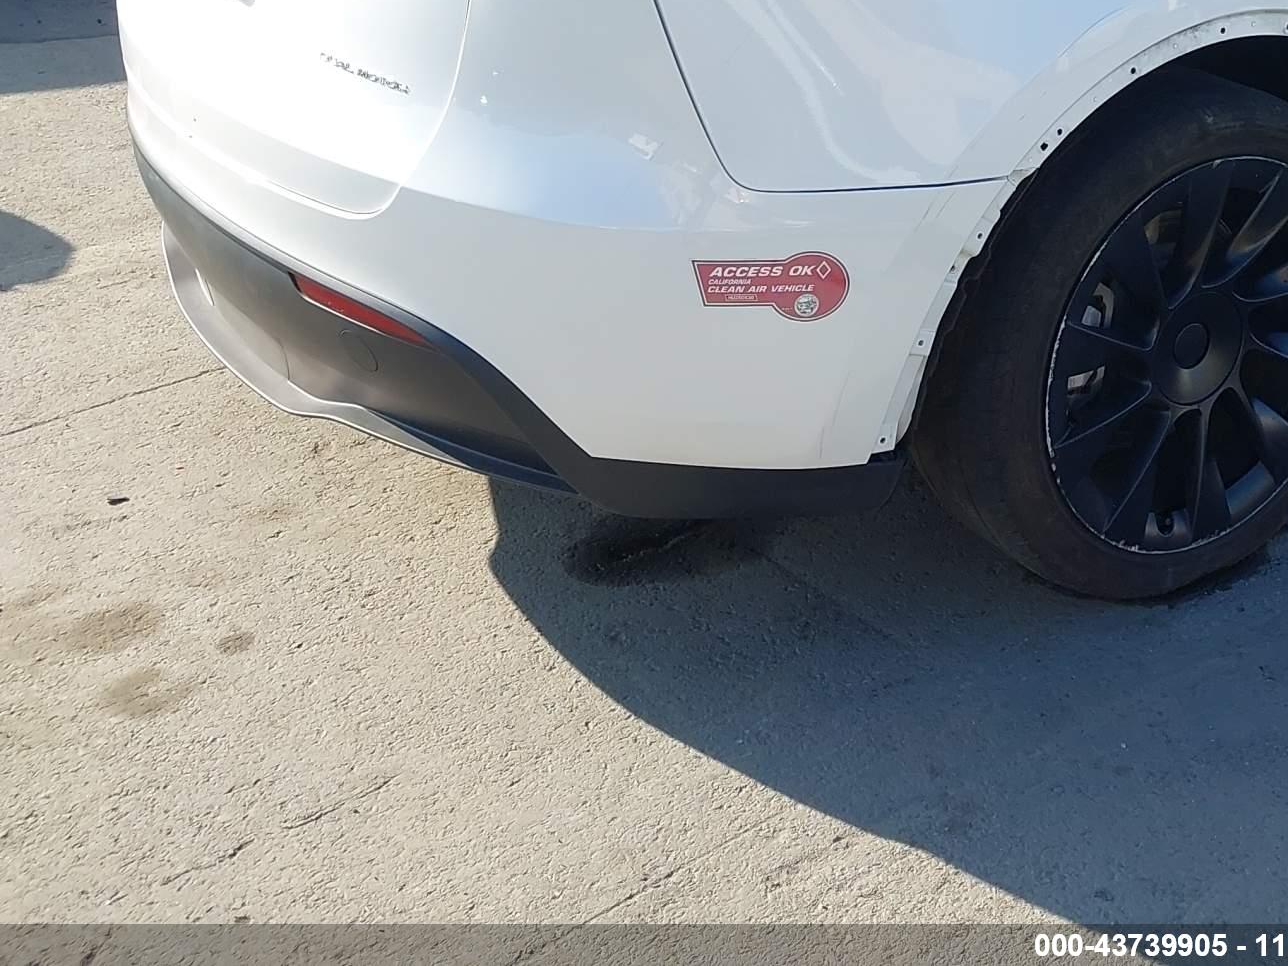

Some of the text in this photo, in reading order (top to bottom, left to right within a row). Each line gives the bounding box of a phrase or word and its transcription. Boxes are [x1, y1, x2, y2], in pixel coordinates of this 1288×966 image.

[709, 265, 818, 277] ACCESS OK
[748, 285, 767, 293] AIR
[771, 284, 816, 292] VEHICLE
